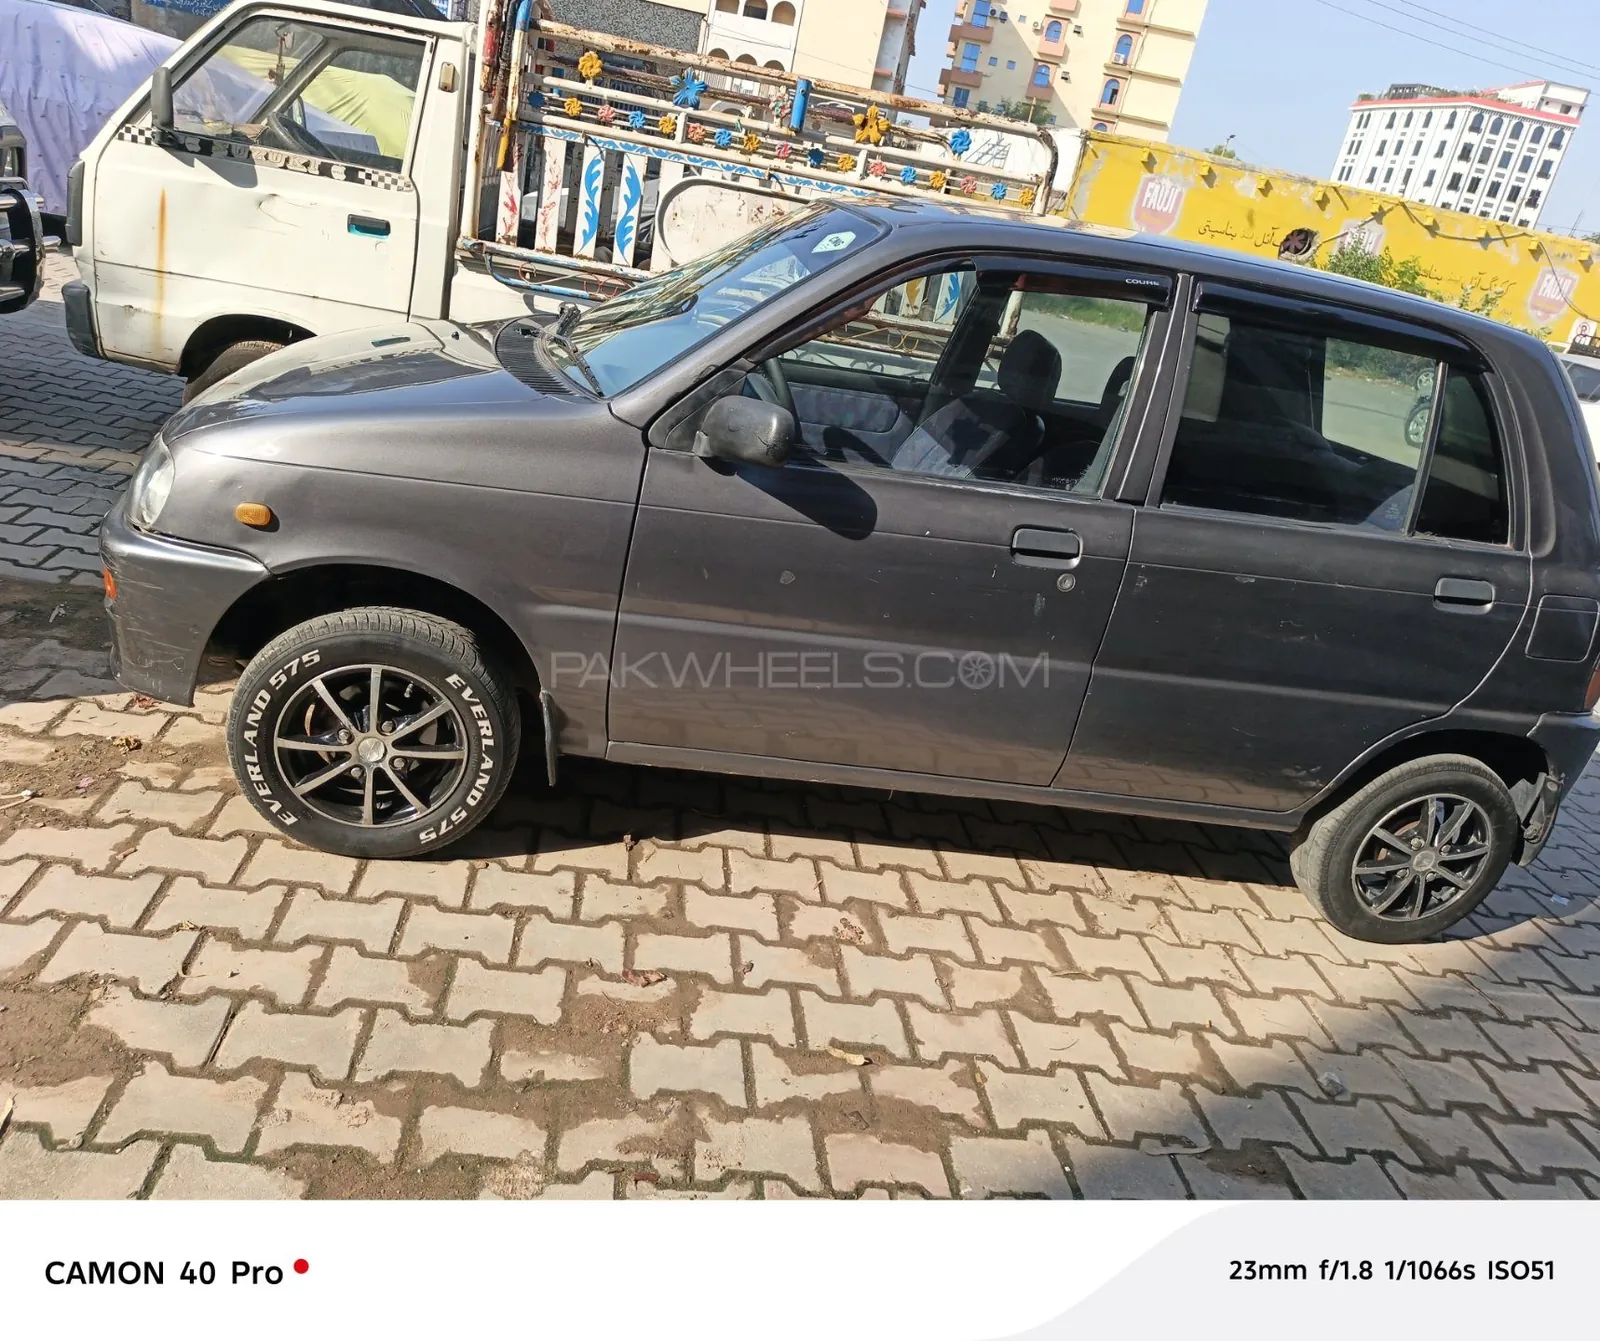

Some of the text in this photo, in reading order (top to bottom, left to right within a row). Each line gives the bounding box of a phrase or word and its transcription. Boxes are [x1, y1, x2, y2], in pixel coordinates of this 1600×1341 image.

[212, 139, 320, 176] SUZUKI
[1142, 182, 1180, 214] FAUJI
[244, 649, 321, 827] EVERLAND 575
[419, 673, 495, 844] EVERLAND 575
